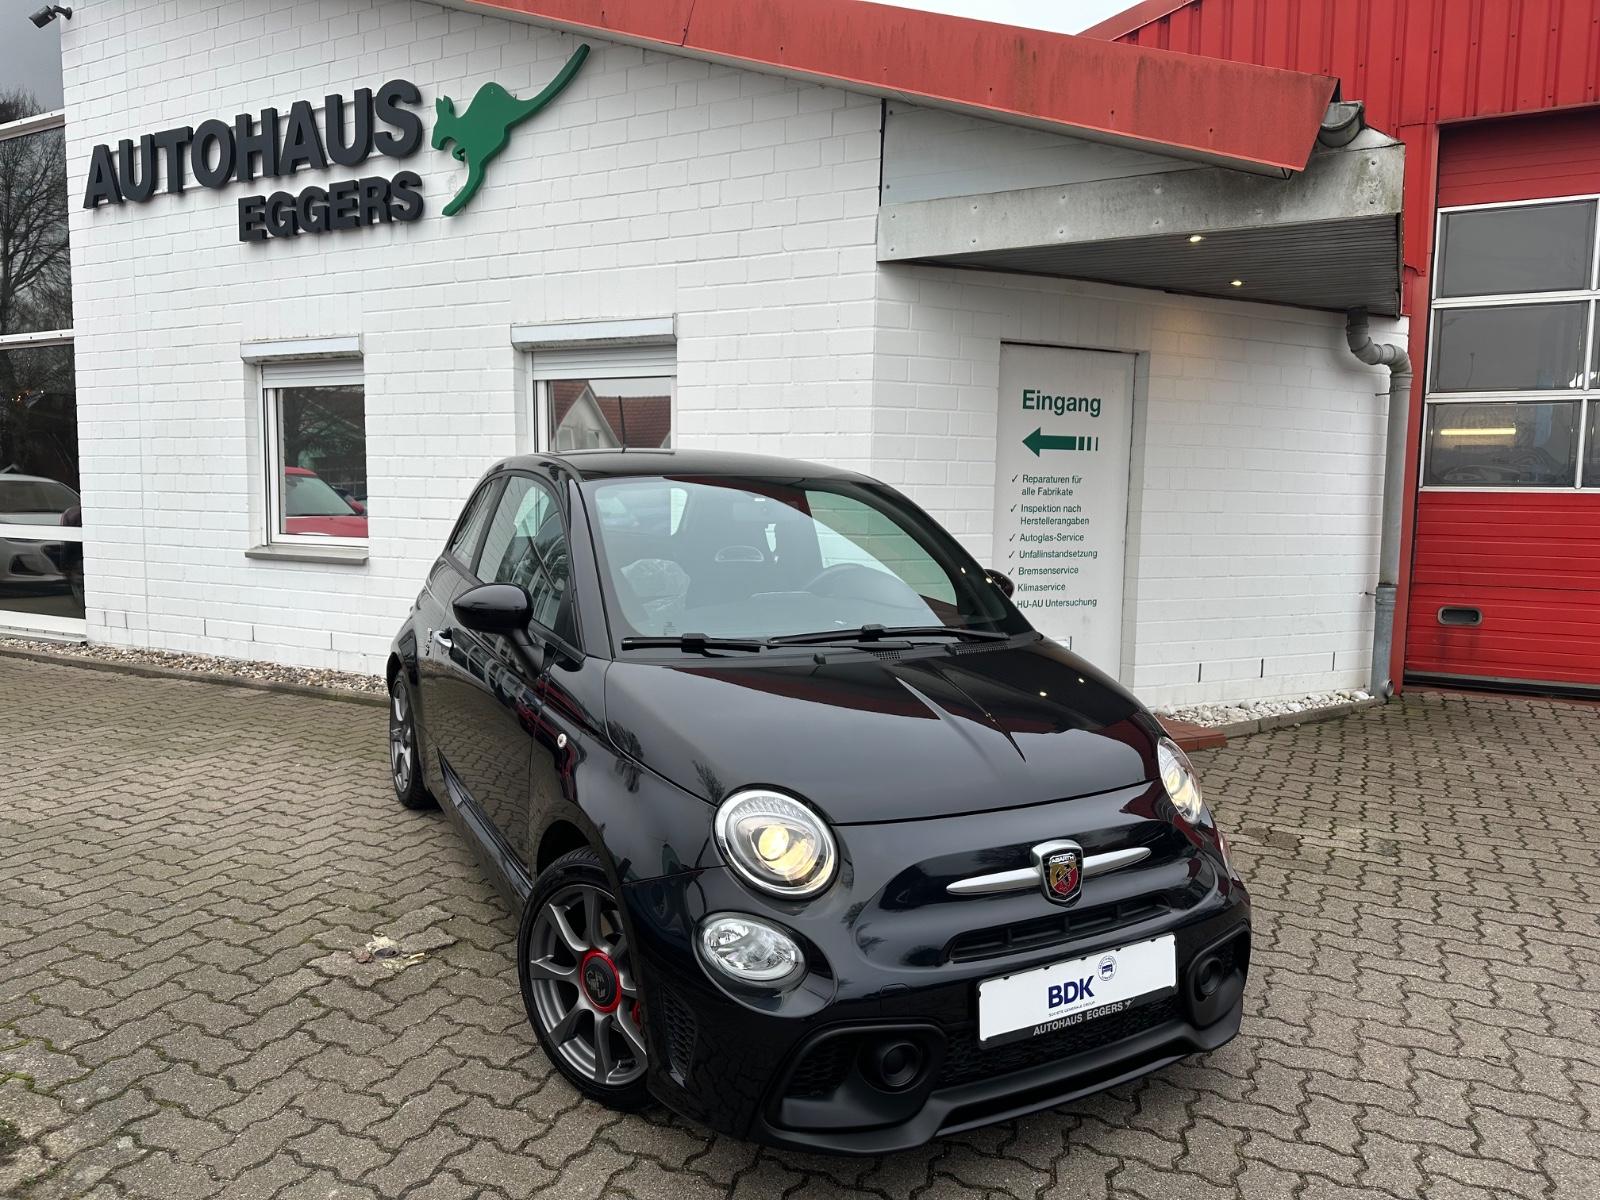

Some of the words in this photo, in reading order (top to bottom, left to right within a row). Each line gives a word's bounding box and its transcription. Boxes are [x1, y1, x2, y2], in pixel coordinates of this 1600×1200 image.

[83, 79, 423, 210] AUTOHAUS
[238, 171, 424, 242] EGGERS
[1022, 389, 1101, 417] Eingang
[1022, 474, 1070, 484] Reparaturen
[1071, 475, 1082, 484] für
[1021, 487, 1036, 496] alle
[1037, 487, 1074, 496] Fabrikate
[1021, 504, 1061, 514] Inspektion
[1063, 504, 1082, 513] nach
[1020, 517, 1090, 526] Herstellerangaben
[1019, 533, 1085, 543] Autoglas-Service
[1019, 550, 1098, 559] Unfallinstandsetzung
[1018, 567, 1079, 576] Bremsenservice
[1017, 583, 1066, 592] Klimaservice
[1016, 600, 1044, 609] HU-AU
[1045, 598, 1098, 608] Untersuchung
[1048, 975, 1095, 1009] BDK
[1033, 1013, 1083, 1036] AUTOHAUS
[1086, 1002, 1124, 1021] EGGERS
